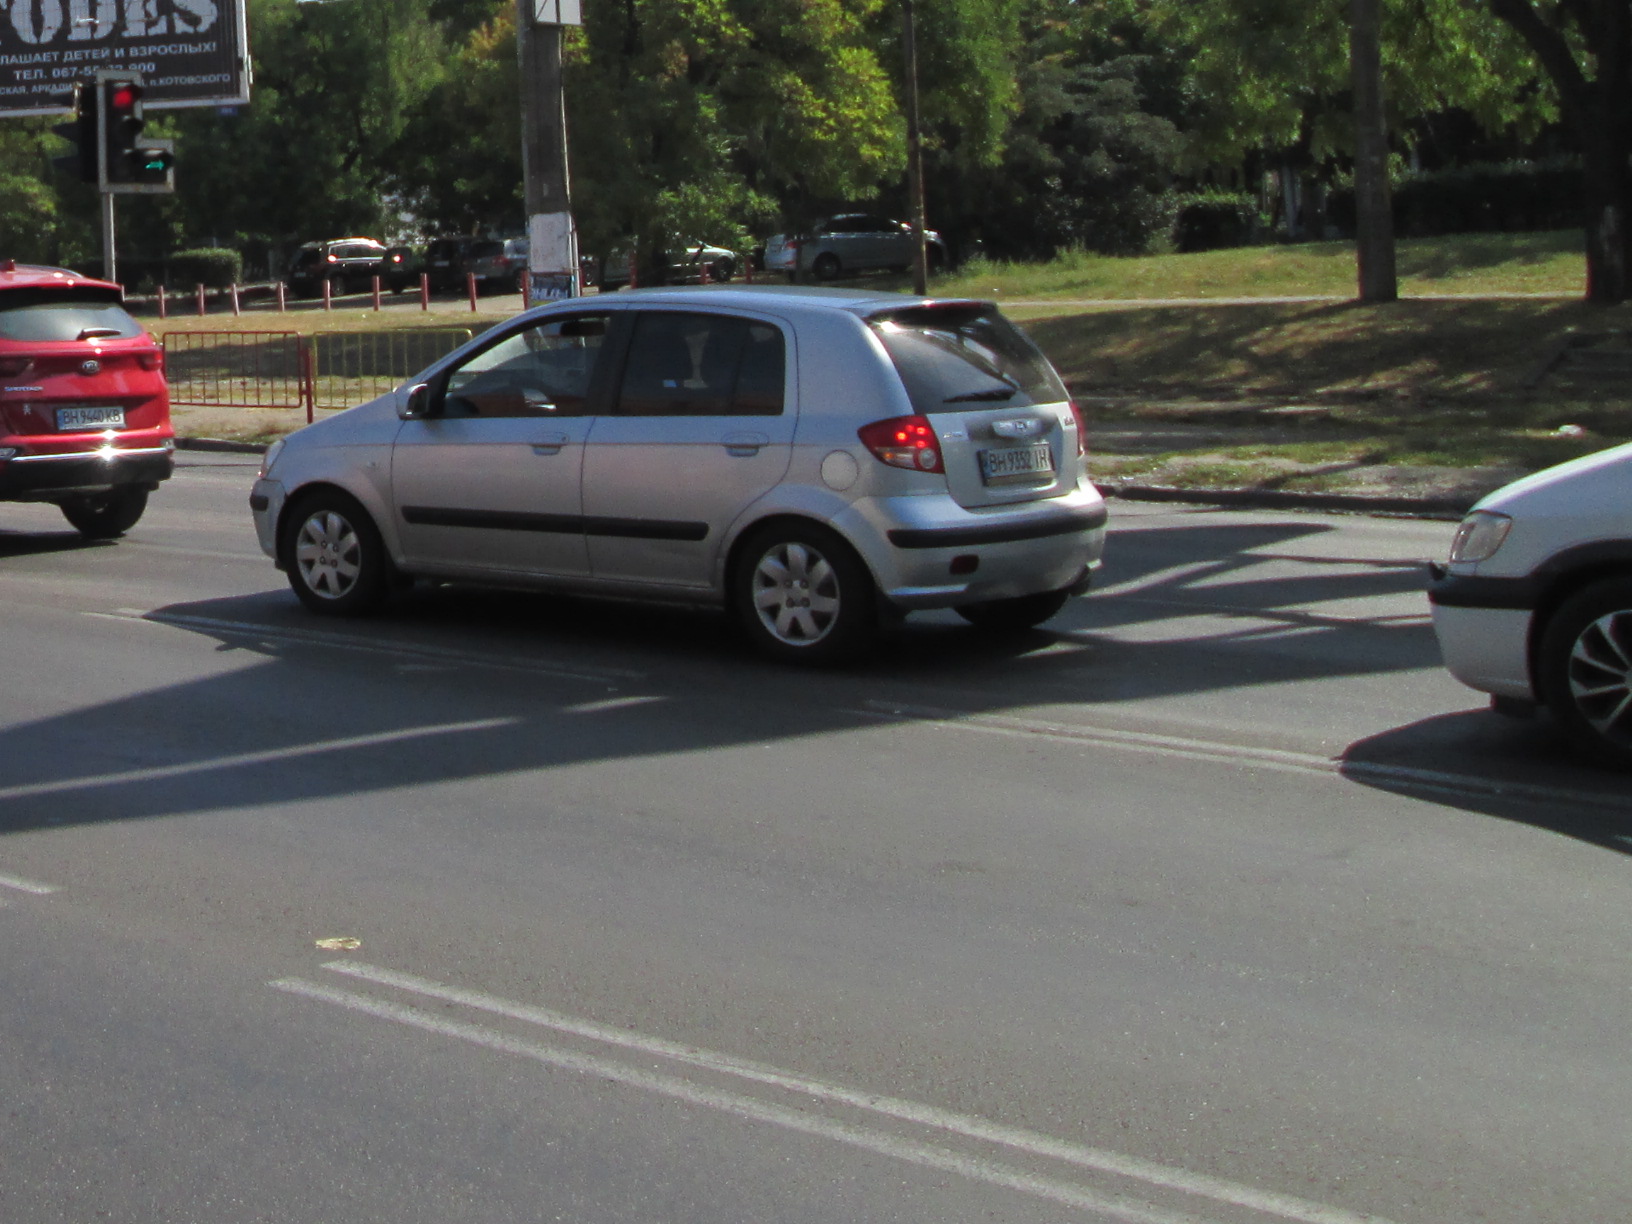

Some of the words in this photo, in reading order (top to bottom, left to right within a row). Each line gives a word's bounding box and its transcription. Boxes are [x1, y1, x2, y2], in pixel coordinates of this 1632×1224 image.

[63, 47, 111, 63] ДЕТЕЙ
[114, 47, 125, 59] И
[129, 42, 217, 56] ВЗРОСЛЫХ!
[14, 69, 48, 81] ТЕЛ.
[31, 82, 76, 94] АРКАДИ
